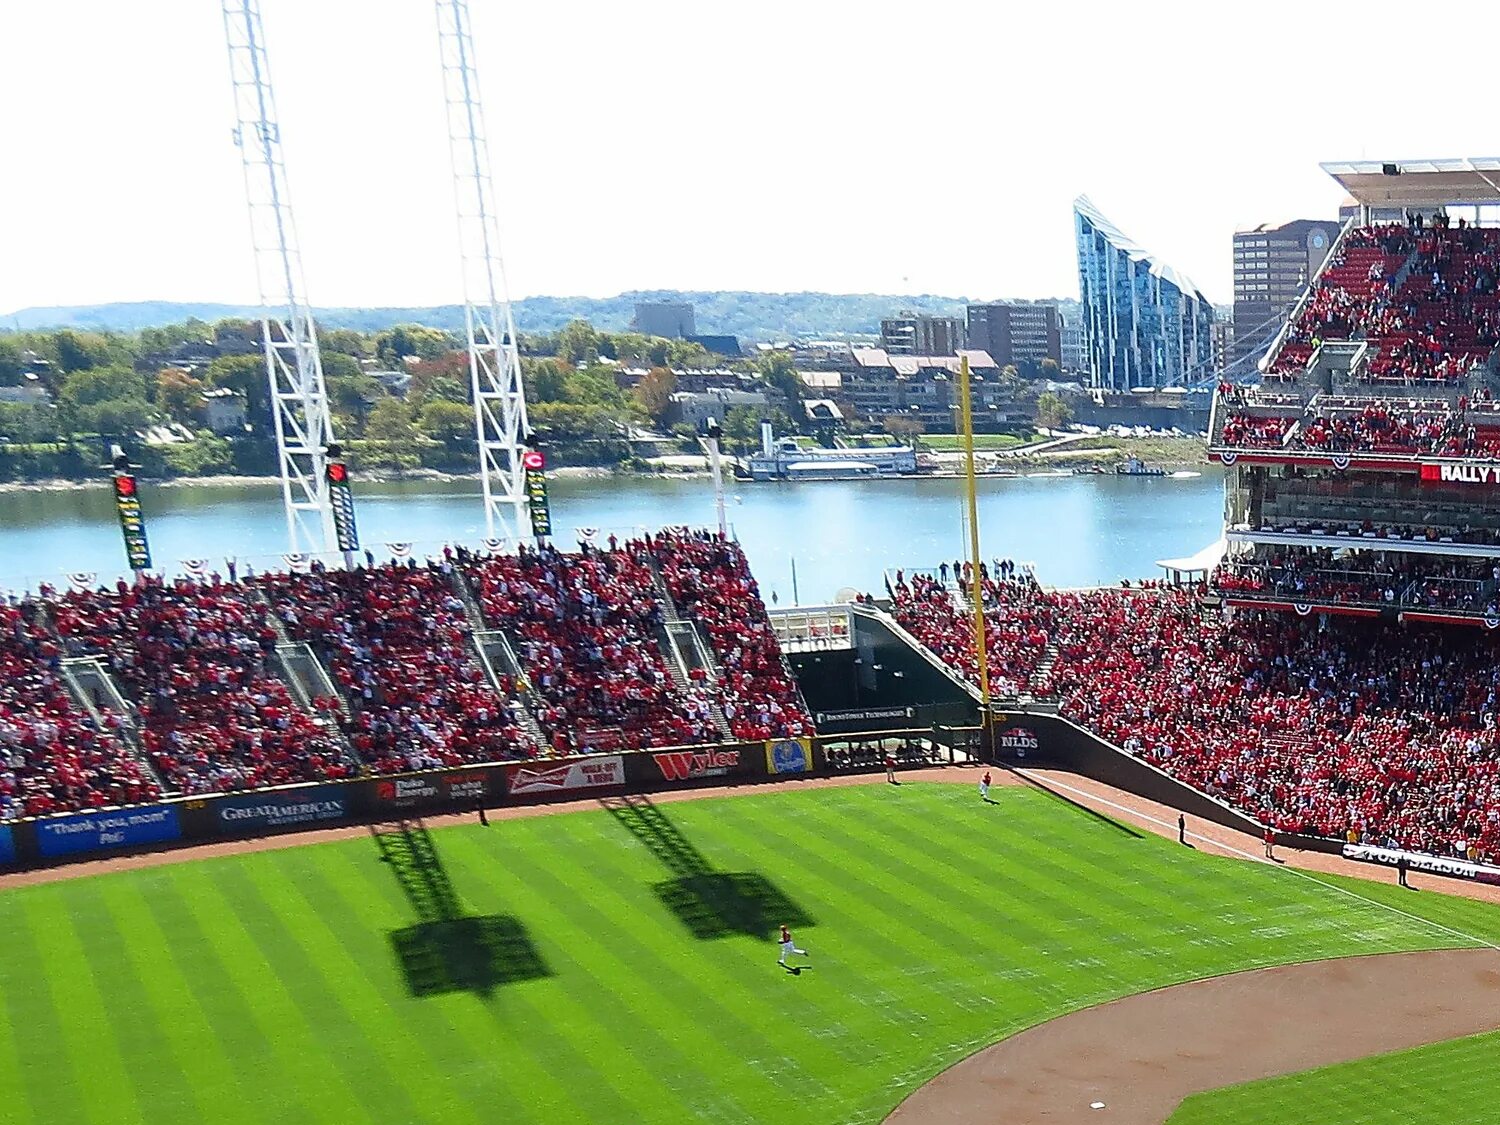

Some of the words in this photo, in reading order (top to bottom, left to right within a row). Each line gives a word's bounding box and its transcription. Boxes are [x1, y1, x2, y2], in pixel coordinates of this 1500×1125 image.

[1440, 465, 1490, 484] RALLY
[1000, 736, 1038, 749] NLDS
[653, 748, 740, 781] Wyler
